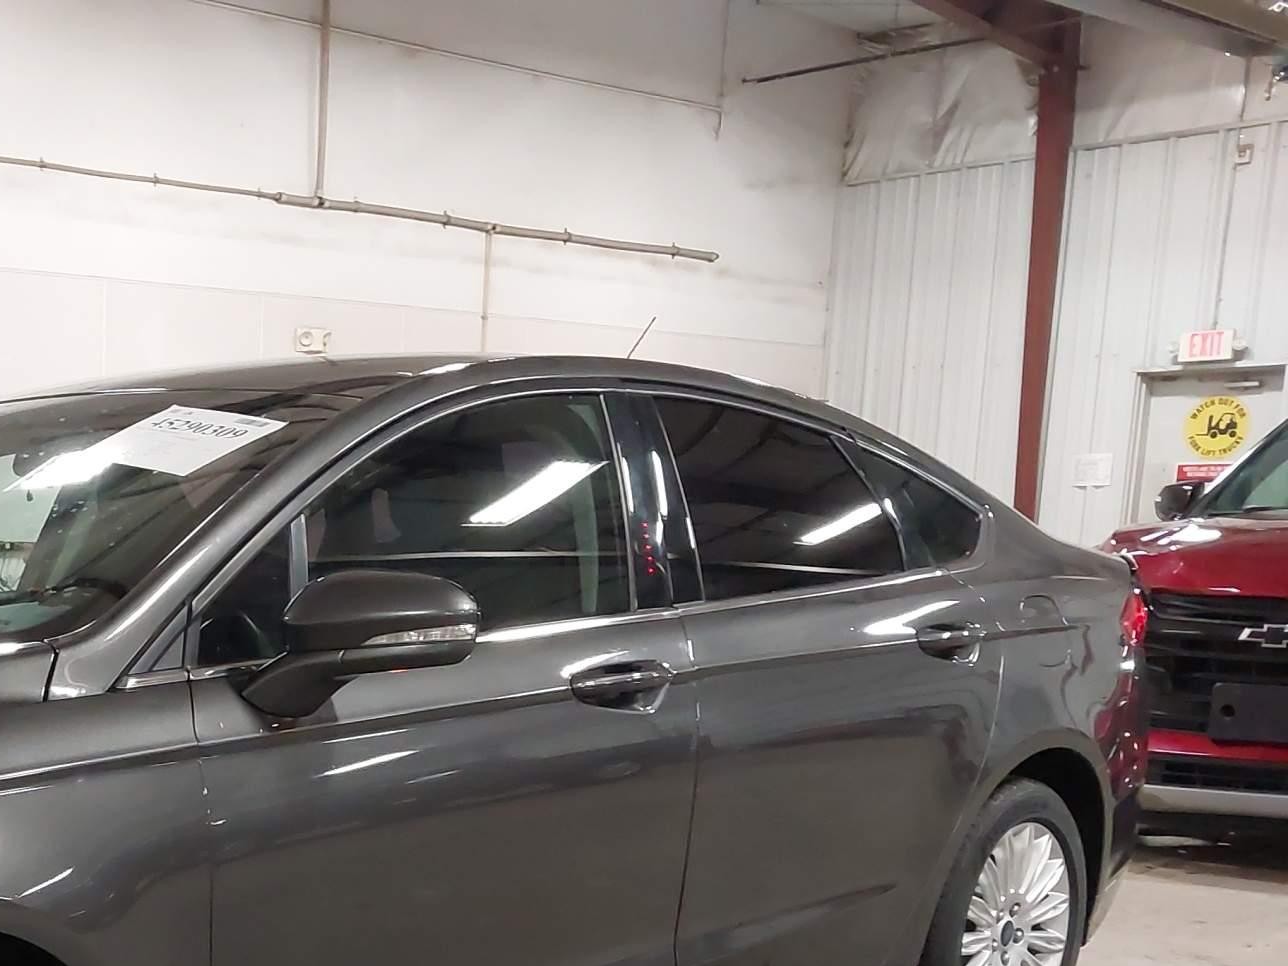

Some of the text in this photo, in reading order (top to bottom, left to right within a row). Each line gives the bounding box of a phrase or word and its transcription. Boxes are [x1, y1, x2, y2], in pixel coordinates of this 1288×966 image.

[1189, 331, 1225, 359] EXIT
[1190, 397, 1247, 420] WATCH OUT FOR
[151, 417, 249, 439] 45290309
[1201, 447, 1216, 457] LIFT
